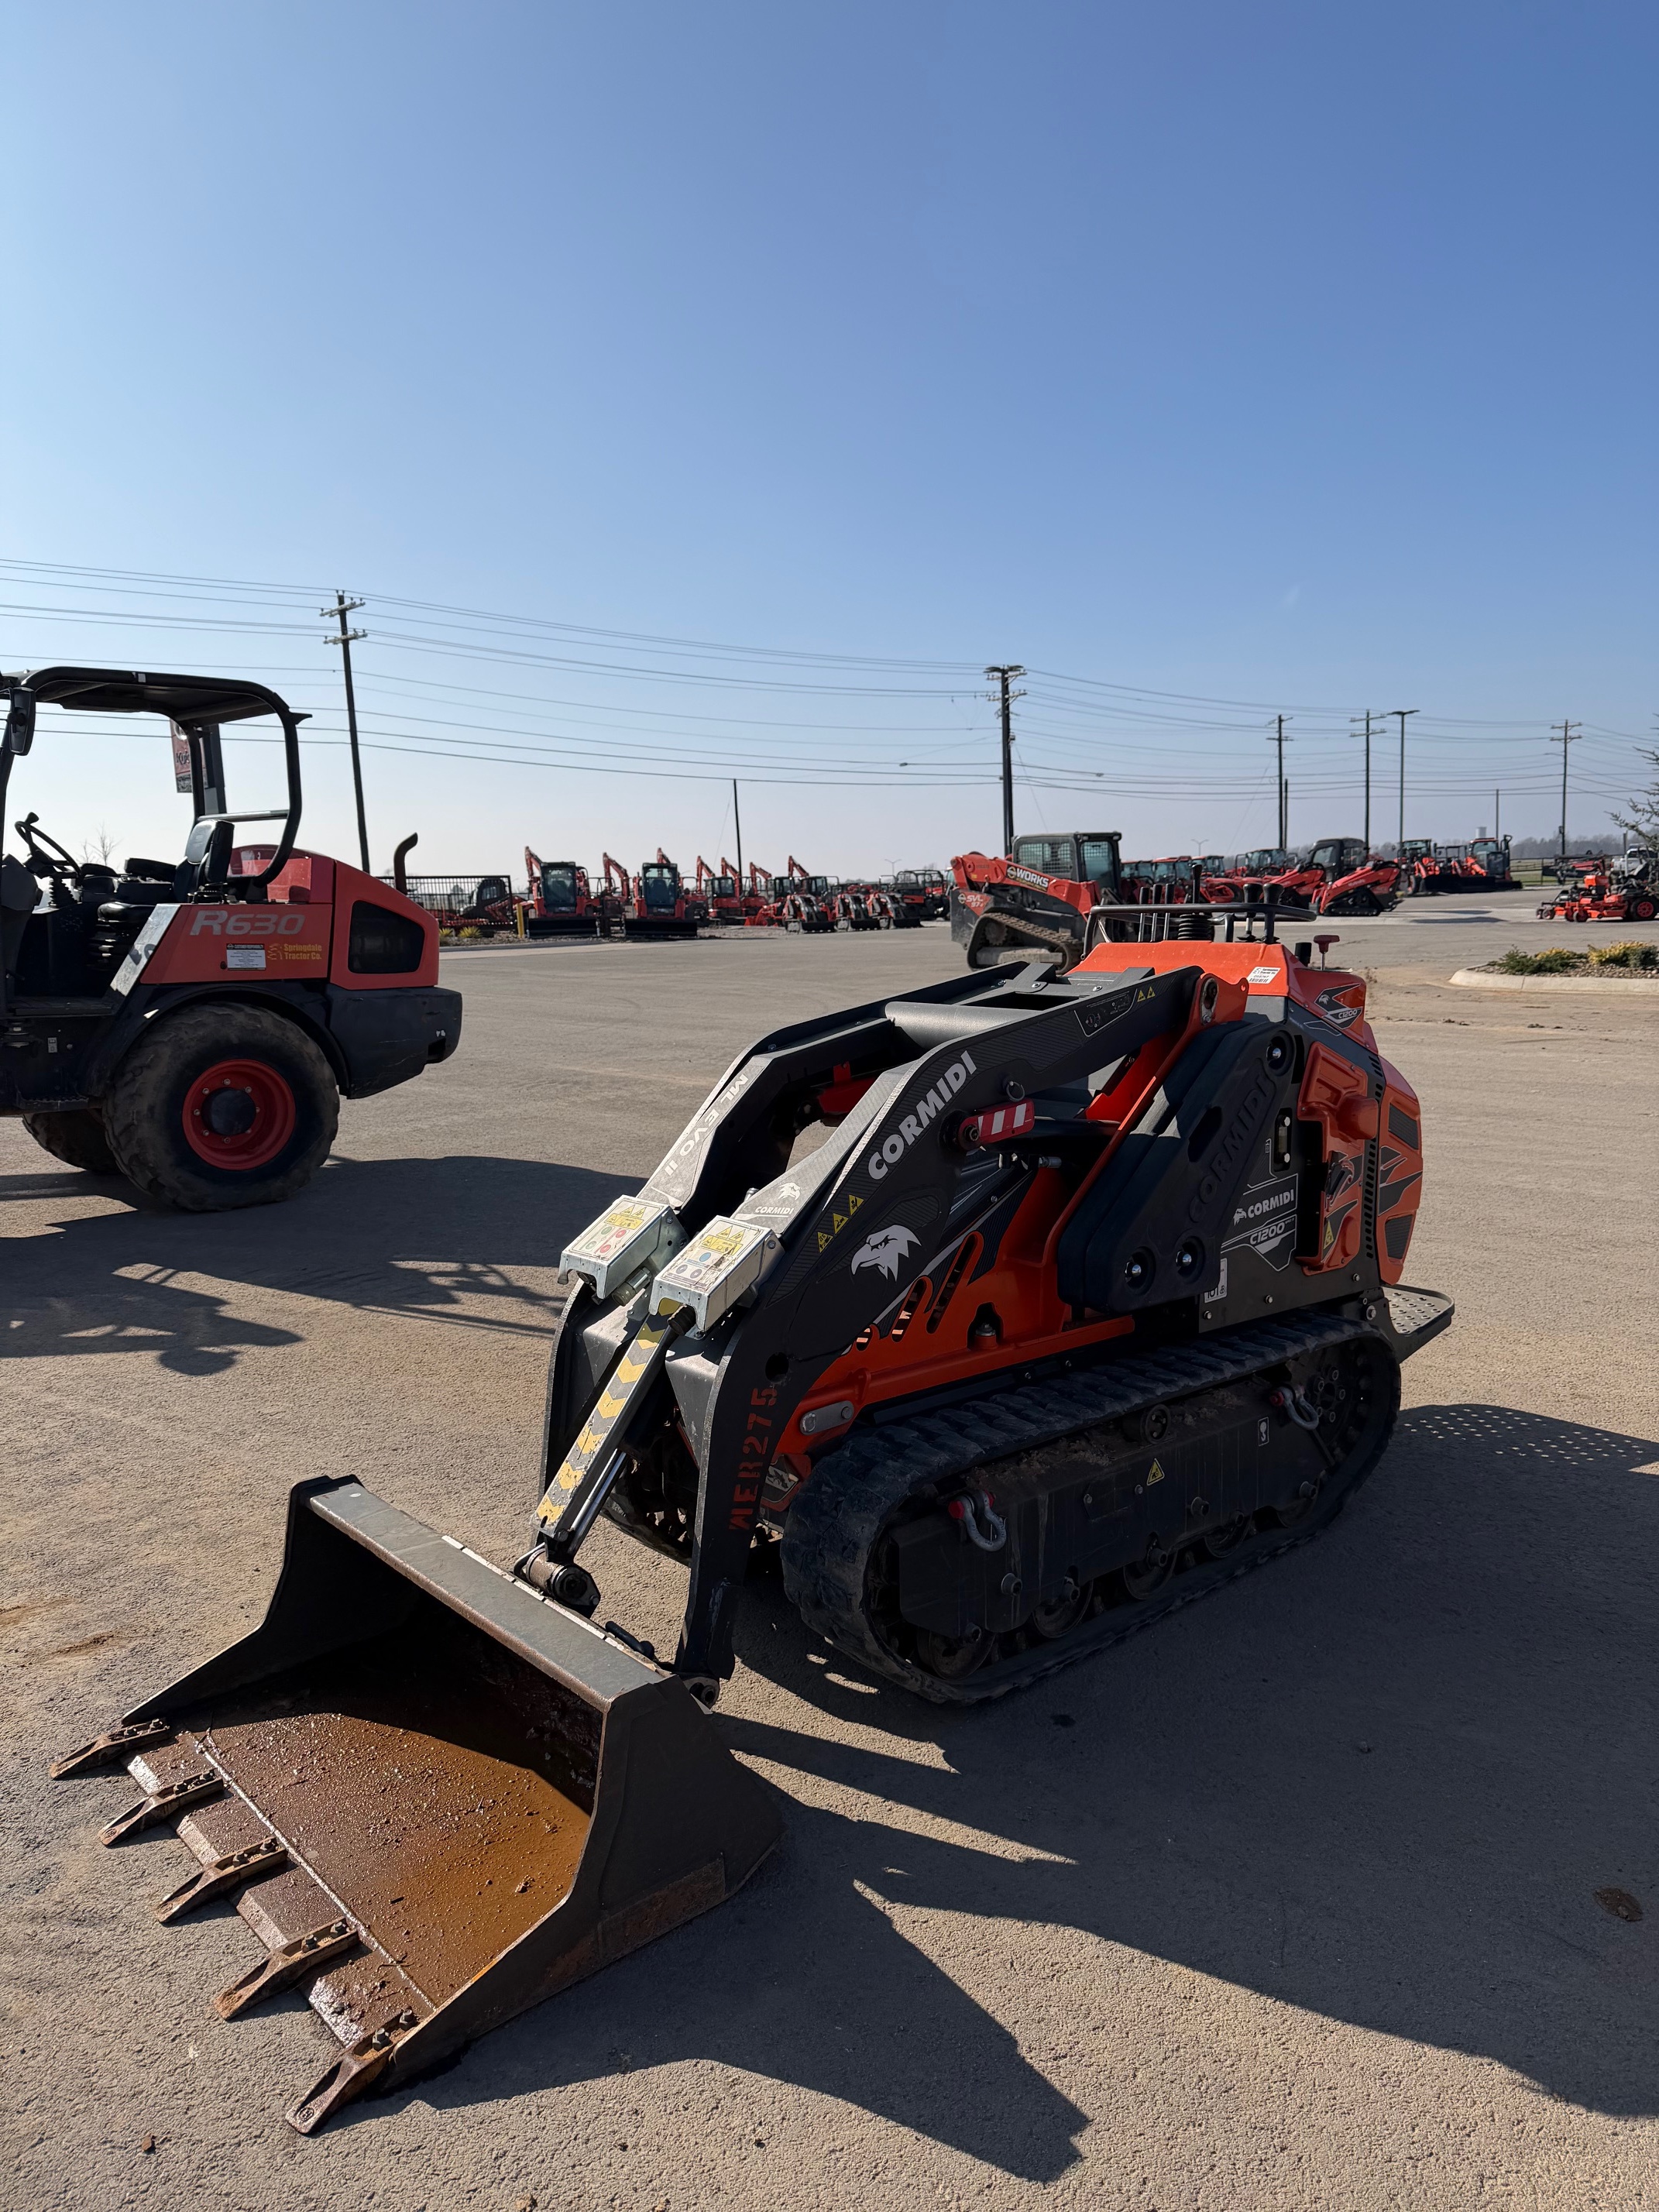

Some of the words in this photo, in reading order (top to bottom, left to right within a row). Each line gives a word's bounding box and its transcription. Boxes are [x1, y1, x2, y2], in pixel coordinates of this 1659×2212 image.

[1016, 867, 1049, 888] WORKS
[966, 894, 984, 902] SVL
[189, 910, 306, 936] R630
[283, 943, 322, 952] Springdale
[311, 952, 322, 960] Co.
[1338, 1009, 1358, 1019] C1200
[867, 1050, 977, 1180] CORMIDI
[679, 1108, 720, 1156] EVO
[1189, 1073, 1268, 1224] CORMIDI
[665, 1159, 678, 1176] II
[754, 1206, 795, 1214] CORMIDI
[1248, 1189, 1294, 1218] CORMIDI
[1249, 1222, 1286, 1245] C1200
